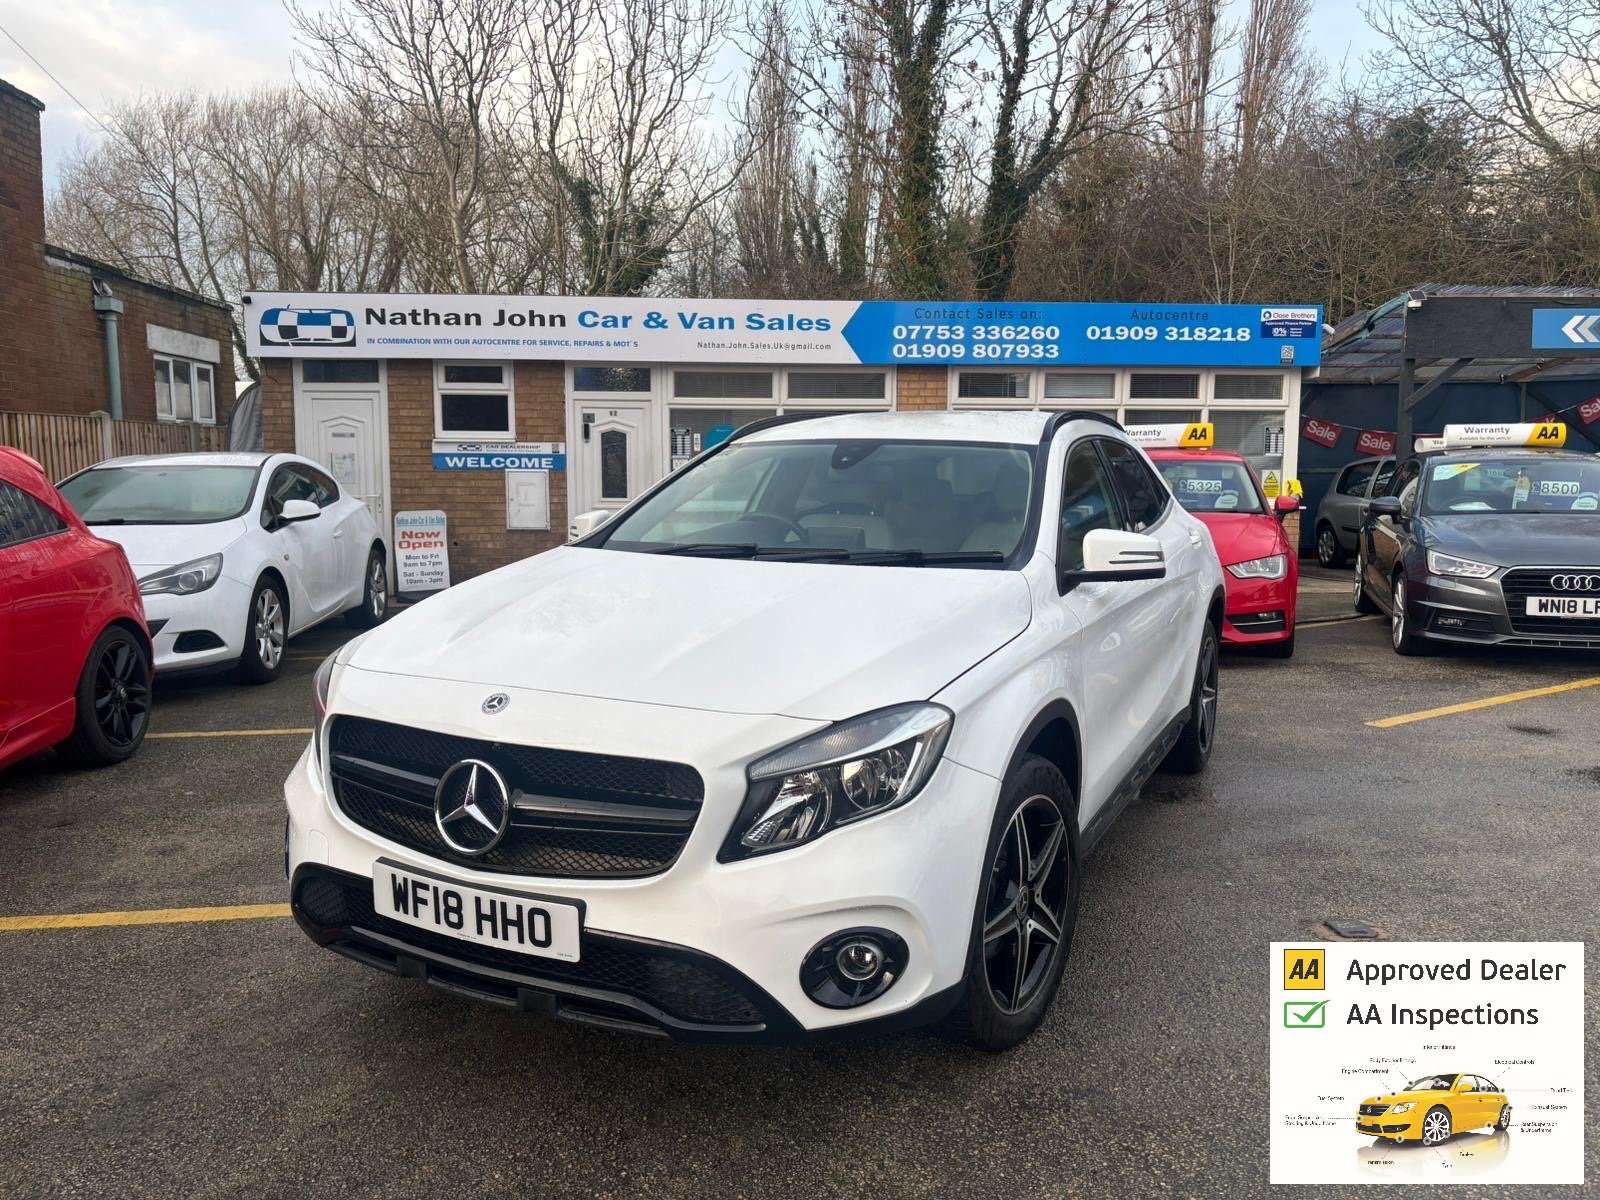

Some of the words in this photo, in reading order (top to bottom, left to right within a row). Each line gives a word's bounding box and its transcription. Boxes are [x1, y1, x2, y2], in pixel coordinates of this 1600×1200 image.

[365, 307, 482, 326] Nathan
[493, 308, 566, 327] John
[578, 310, 632, 329] Car
[643, 311, 668, 330] &
[677, 312, 735, 330] Van
[745, 313, 832, 331] Sales
[914, 308, 970, 319] Contact
[978, 308, 1013, 320] Sales
[1131, 309, 1209, 321] Autocentre
[893, 325, 965, 340] 07753
[971, 325, 1060, 340] 336260
[1086, 325, 1158, 341] 01909
[1165, 326, 1251, 342] 318218
[472, 338, 520, 346] AUTOCENTRE
[893, 344, 966, 358] 01909
[972, 344, 1060, 358] 807933
[1188, 427, 1208, 440] AA
[1306, 420, 1337, 441] Sale
[1463, 426, 1511, 434] Warranty
[1536, 426, 1559, 440] AA
[1360, 433, 1391, 450] Sale
[445, 456, 553, 468] WELCOME
[401, 530, 440, 539] Now
[398, 540, 444, 550] Open
[1538, 598, 1577, 614] WN18
[391, 873, 464, 930] WF18
[474, 896, 553, 949] HHO
